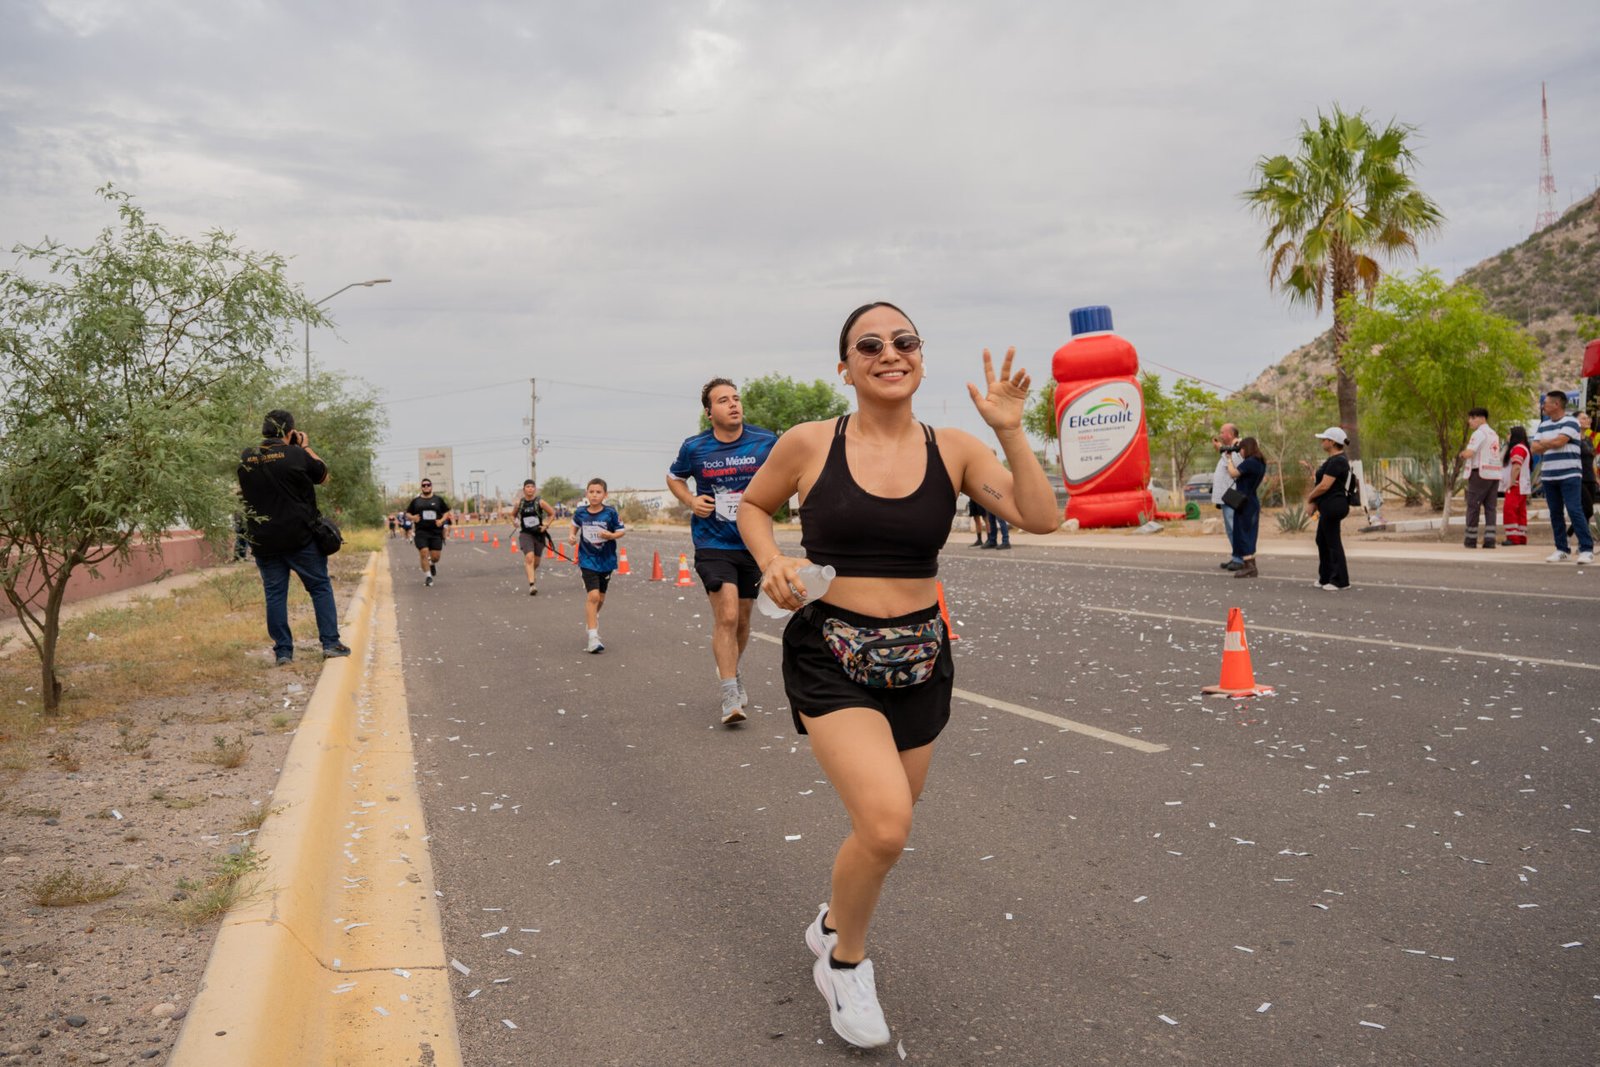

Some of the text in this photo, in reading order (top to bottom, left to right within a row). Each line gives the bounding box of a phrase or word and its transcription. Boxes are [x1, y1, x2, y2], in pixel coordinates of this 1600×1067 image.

[1070, 411, 1132, 428] Electrolit
[703, 456, 756, 468] Todo México
